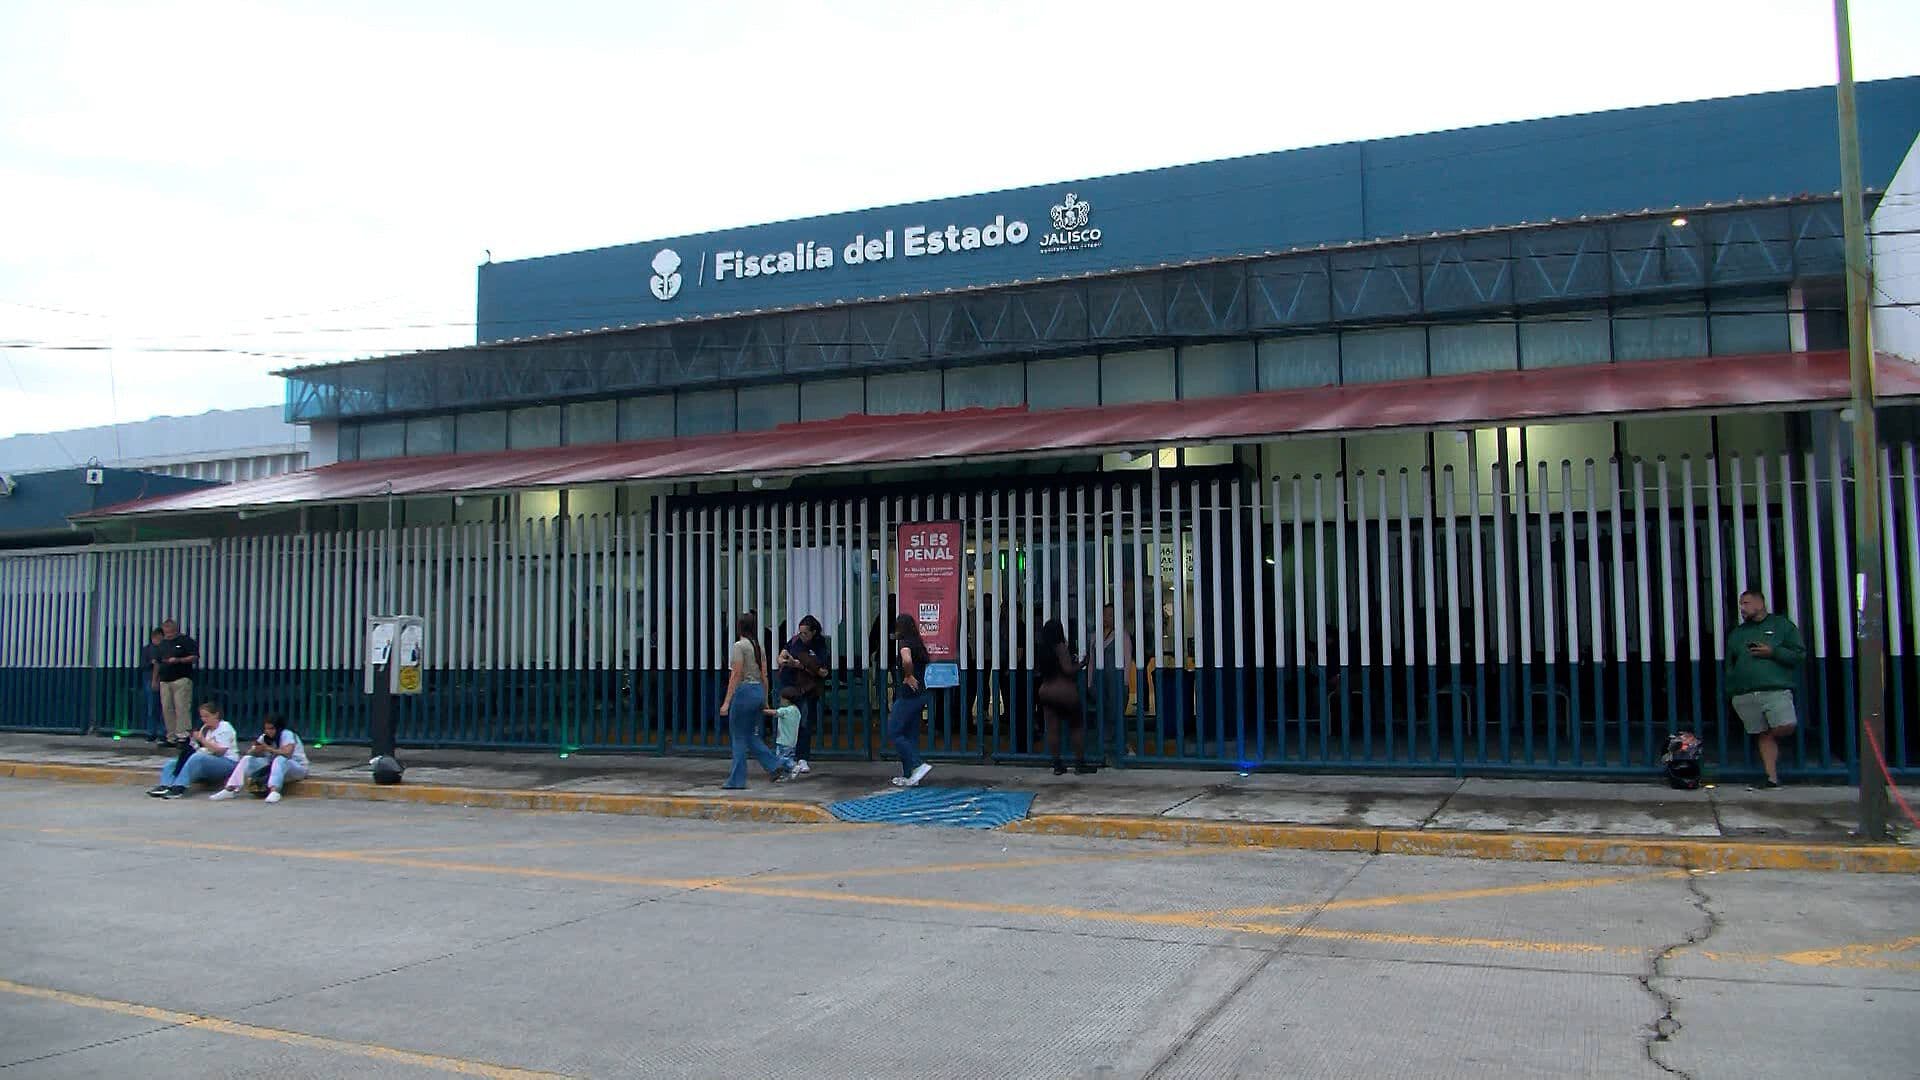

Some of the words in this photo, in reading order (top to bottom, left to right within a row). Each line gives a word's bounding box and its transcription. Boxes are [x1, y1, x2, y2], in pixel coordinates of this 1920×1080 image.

[1040, 229, 1102, 246] JALISCO
[715, 241, 835, 280] Fiscalía
[843, 230, 894, 265] del
[904, 215, 1029, 256] Estado
[910, 531, 926, 546] SÍ
[929, 533, 948, 546] ES
[904, 547, 954, 561] PENAL
